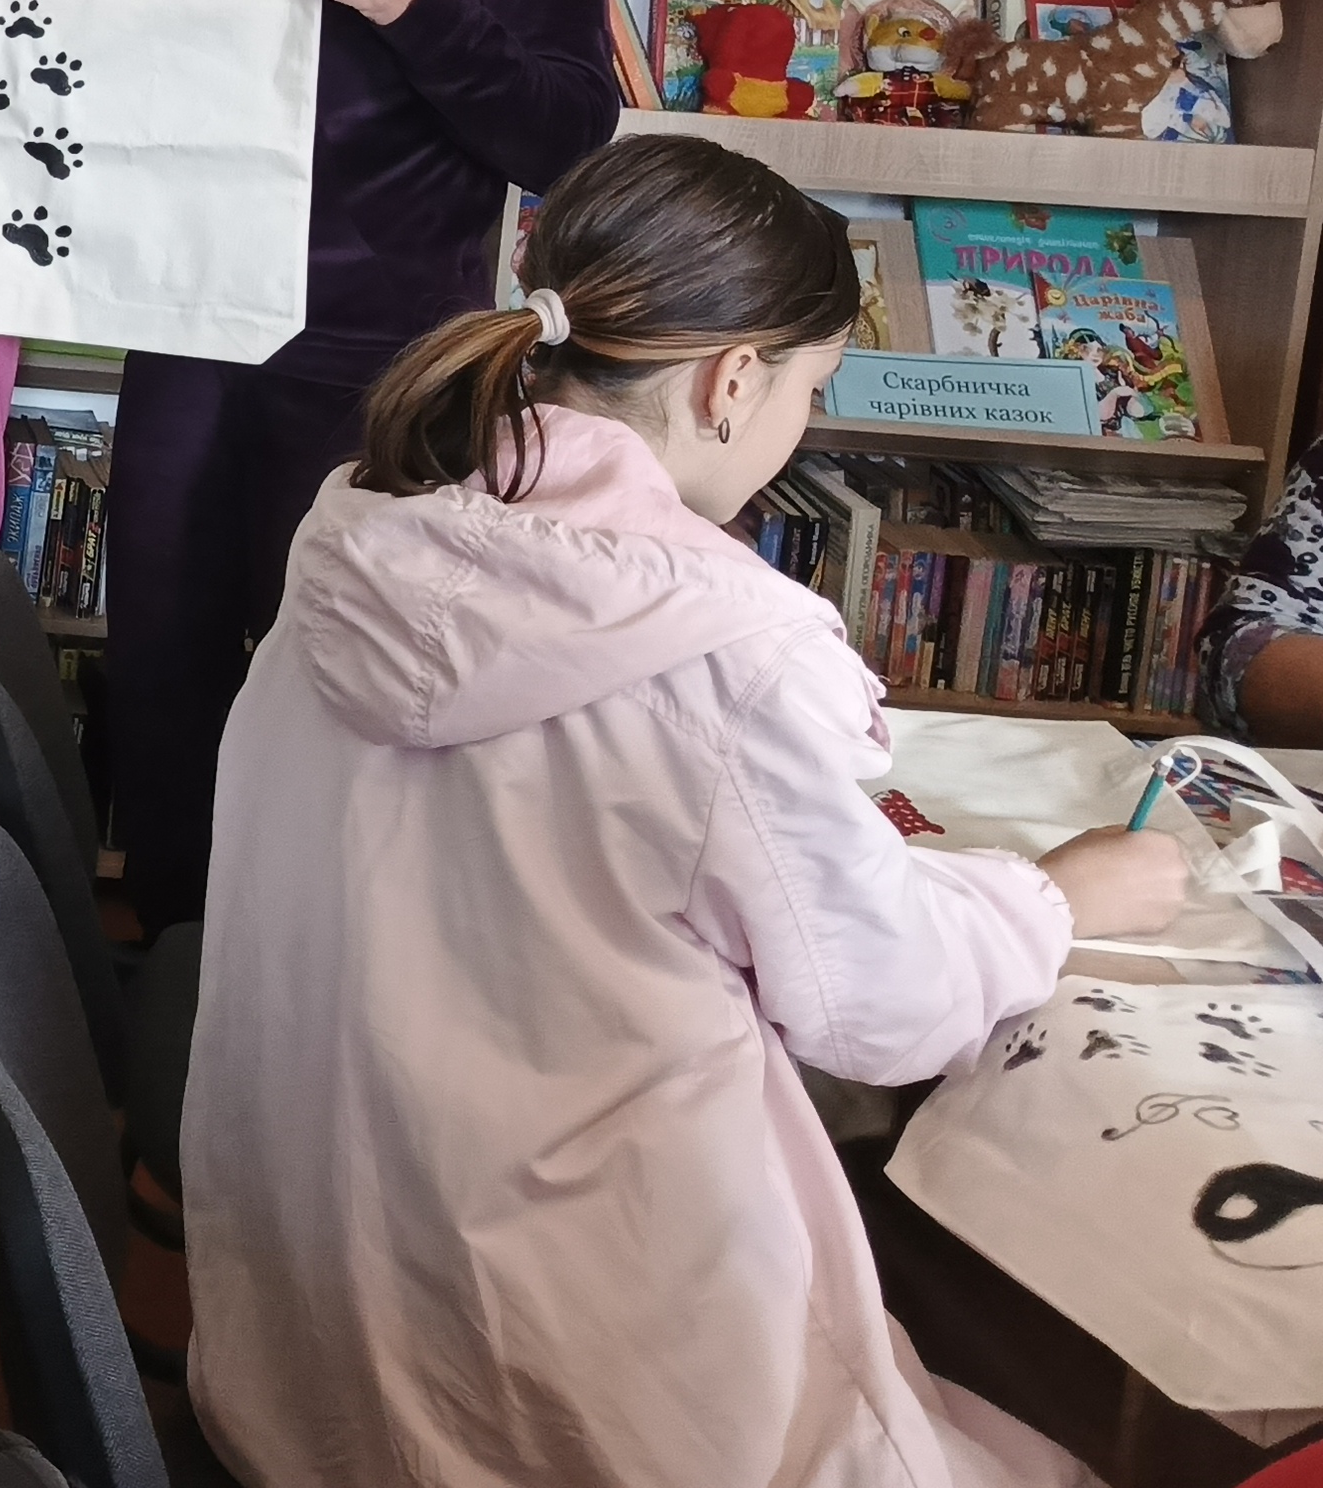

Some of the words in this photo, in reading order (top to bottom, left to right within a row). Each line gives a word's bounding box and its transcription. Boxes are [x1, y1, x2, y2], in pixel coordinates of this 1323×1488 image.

[953, 244, 1121, 278] ПРИРОДА
[1098, 309, 1146, 324] жаба
[882, 370, 1031, 398] Скарбничка
[869, 398, 978, 420] чарівних
[985, 408, 1056, 424] казок
